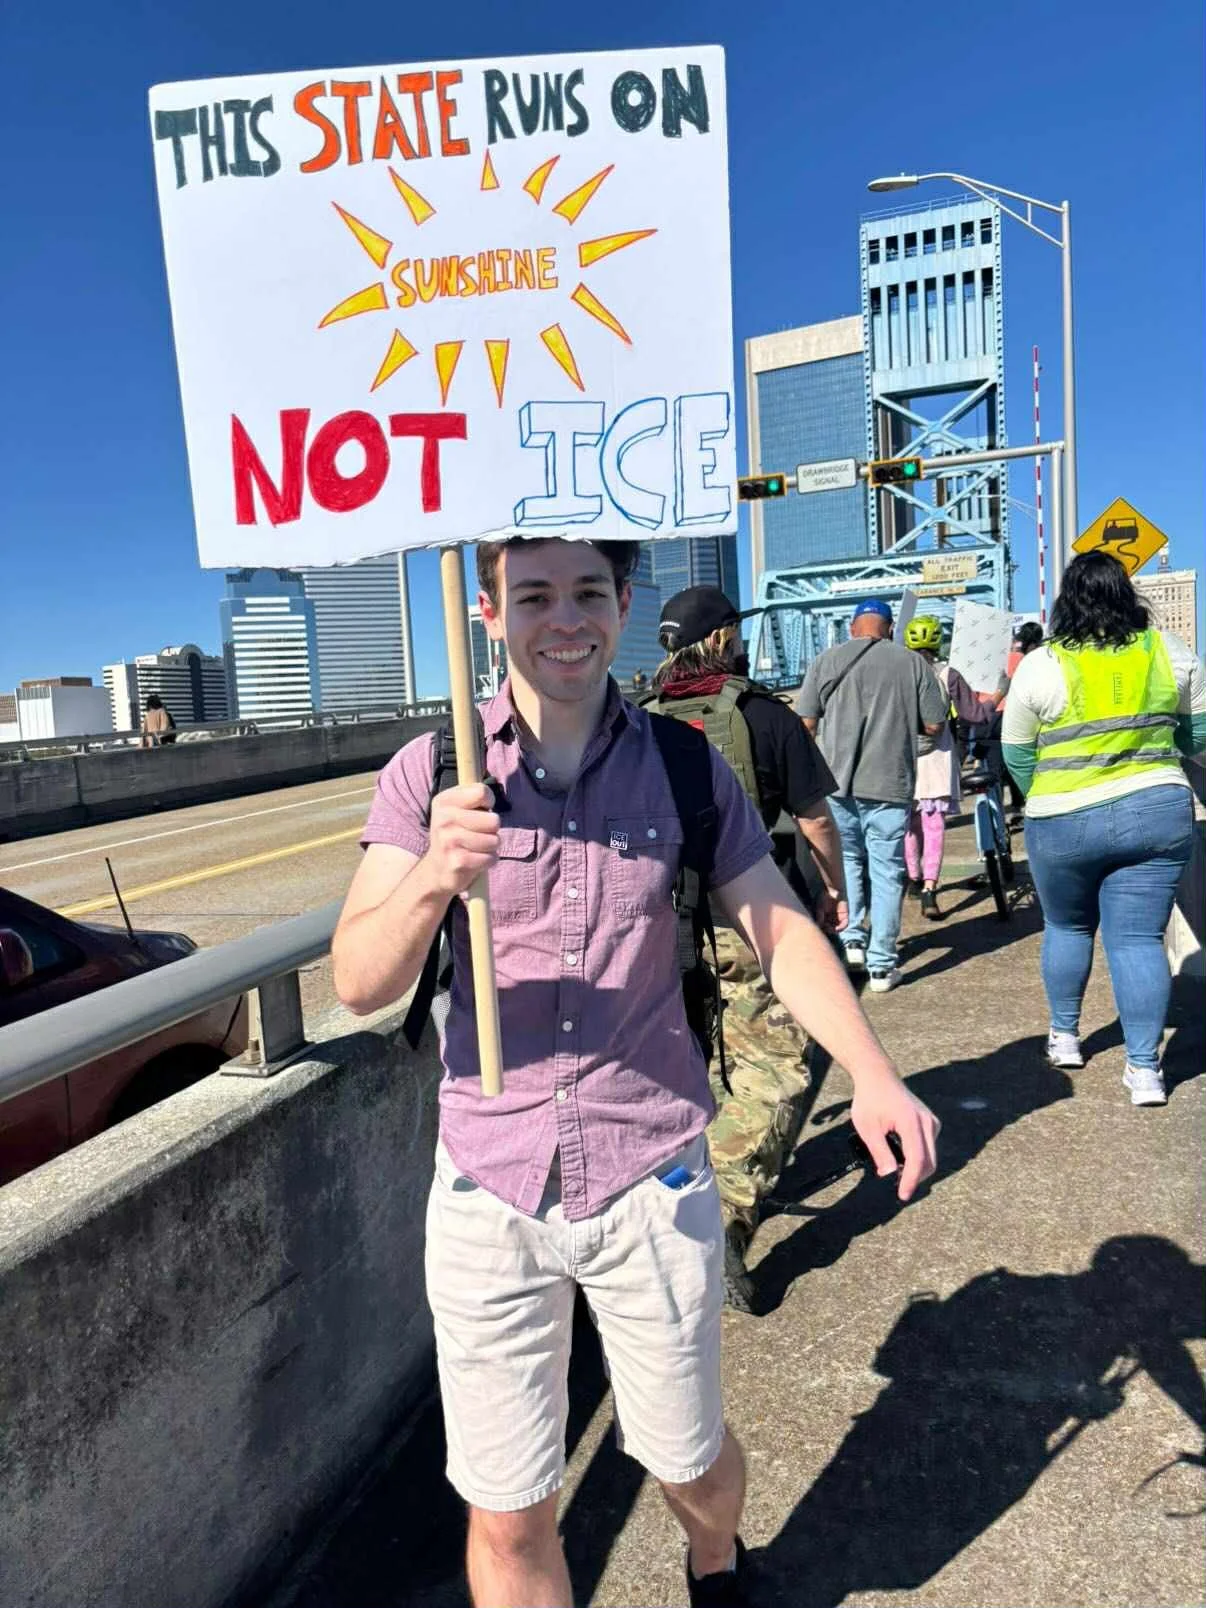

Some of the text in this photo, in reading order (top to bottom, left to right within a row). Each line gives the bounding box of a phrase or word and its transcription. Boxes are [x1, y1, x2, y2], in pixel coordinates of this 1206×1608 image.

[154, 64, 710, 189] THIS STATE RUNS ON
[391, 247, 558, 308] SUNSHINE
[231, 391, 732, 530] NOT ICE
